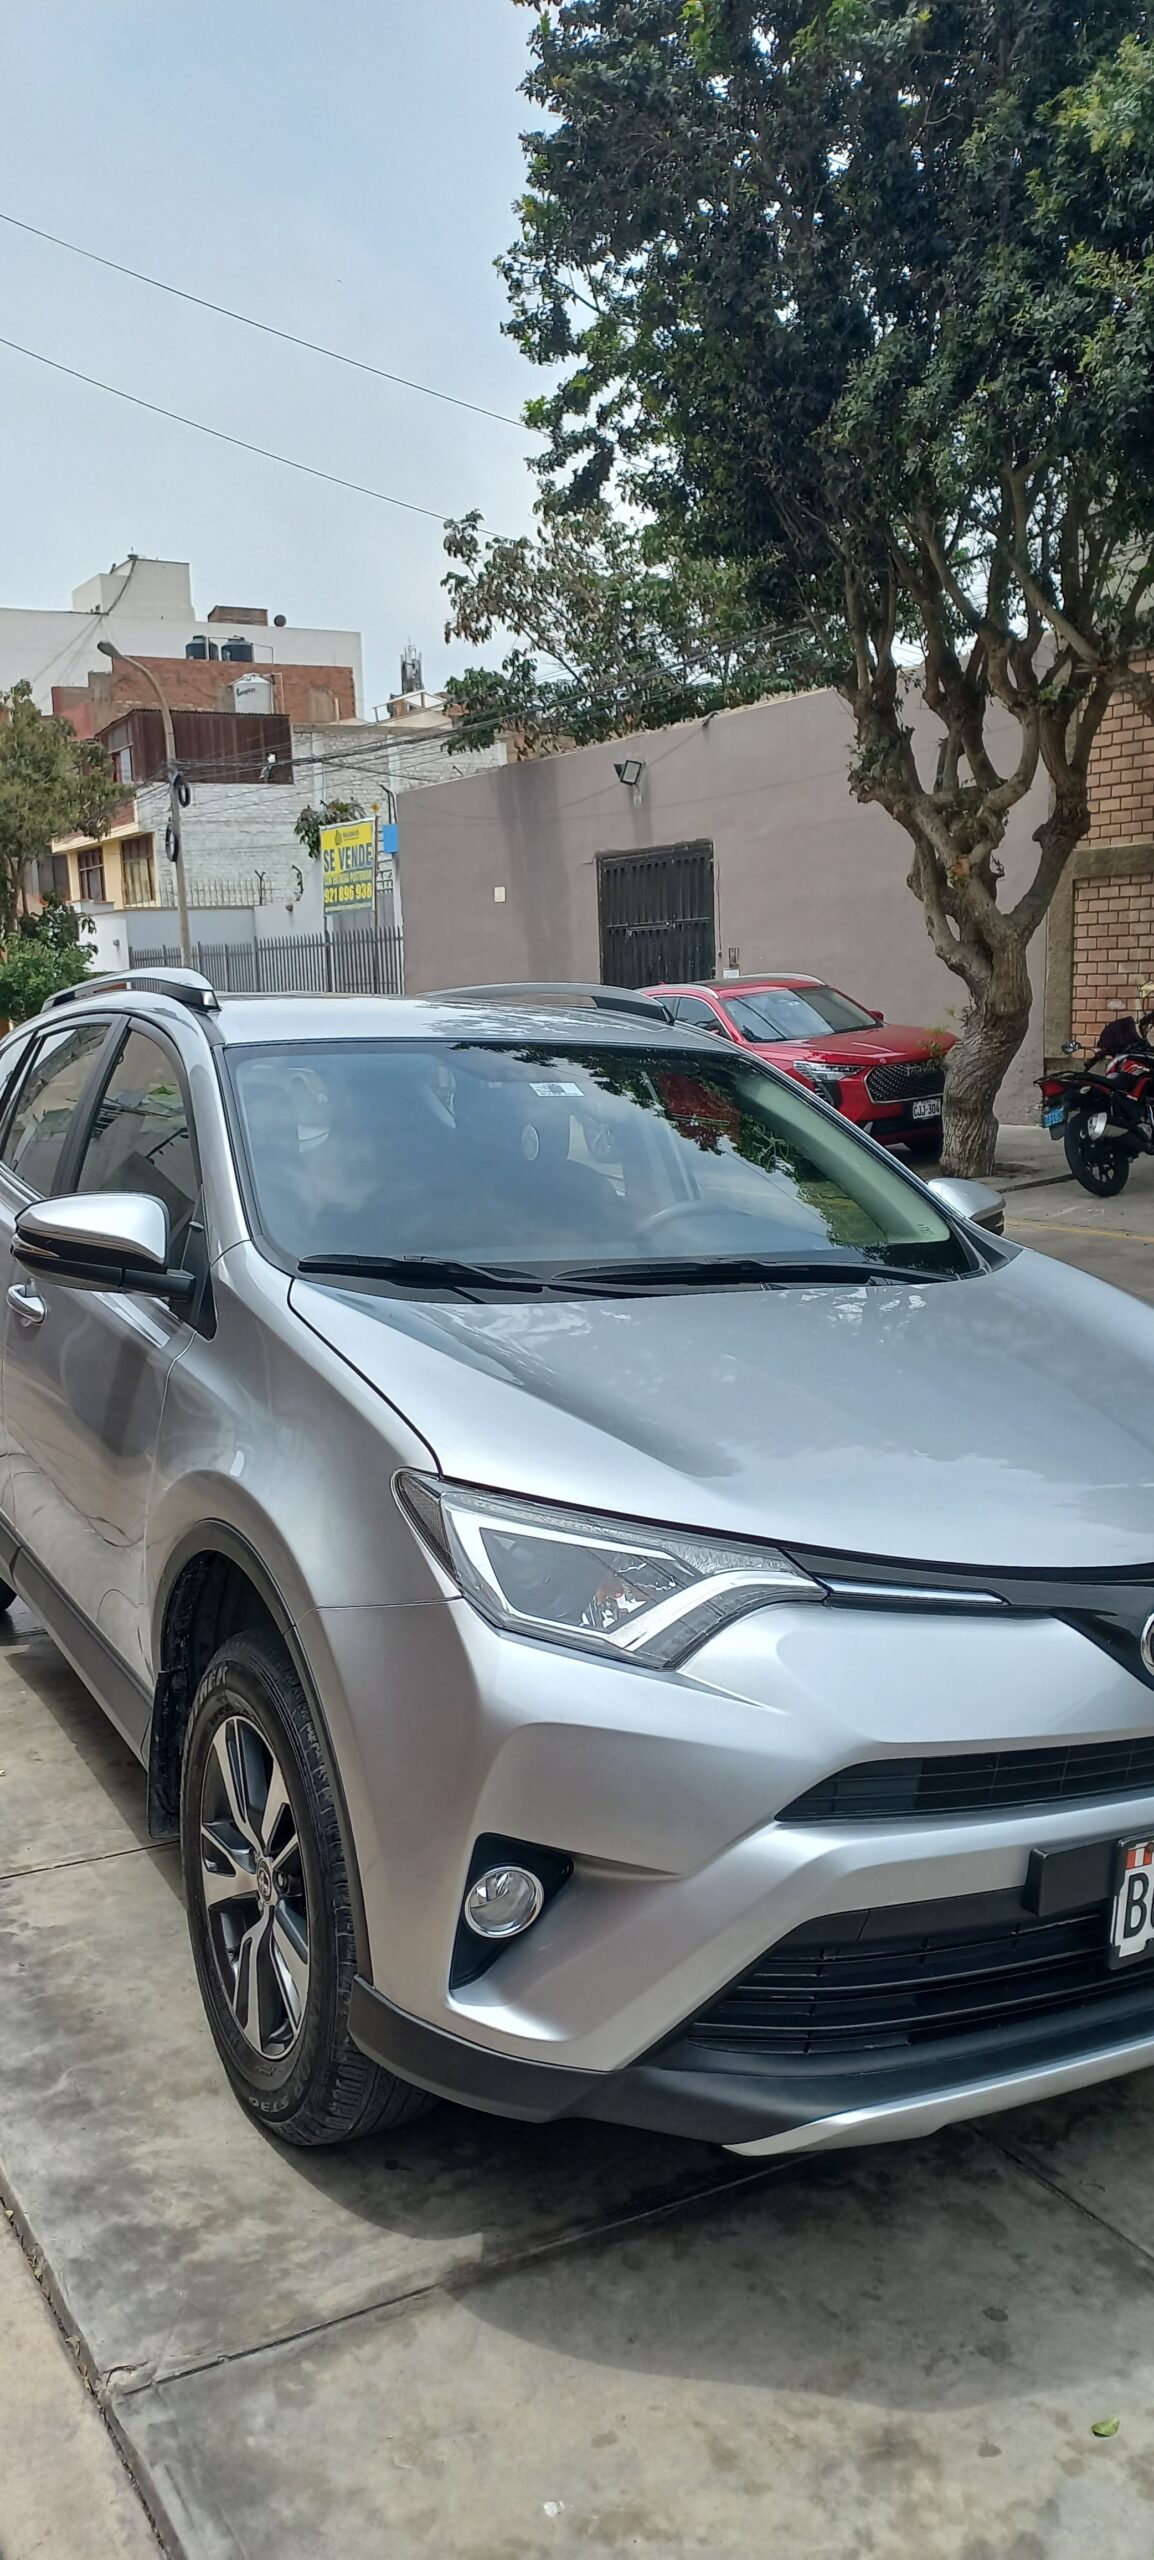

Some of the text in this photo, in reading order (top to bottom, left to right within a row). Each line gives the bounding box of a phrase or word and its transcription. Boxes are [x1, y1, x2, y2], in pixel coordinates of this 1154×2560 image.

[323, 842, 373, 872] SE VENDE
[324, 887, 337, 903] 921
[1123, 1872, 1154, 1939] B
